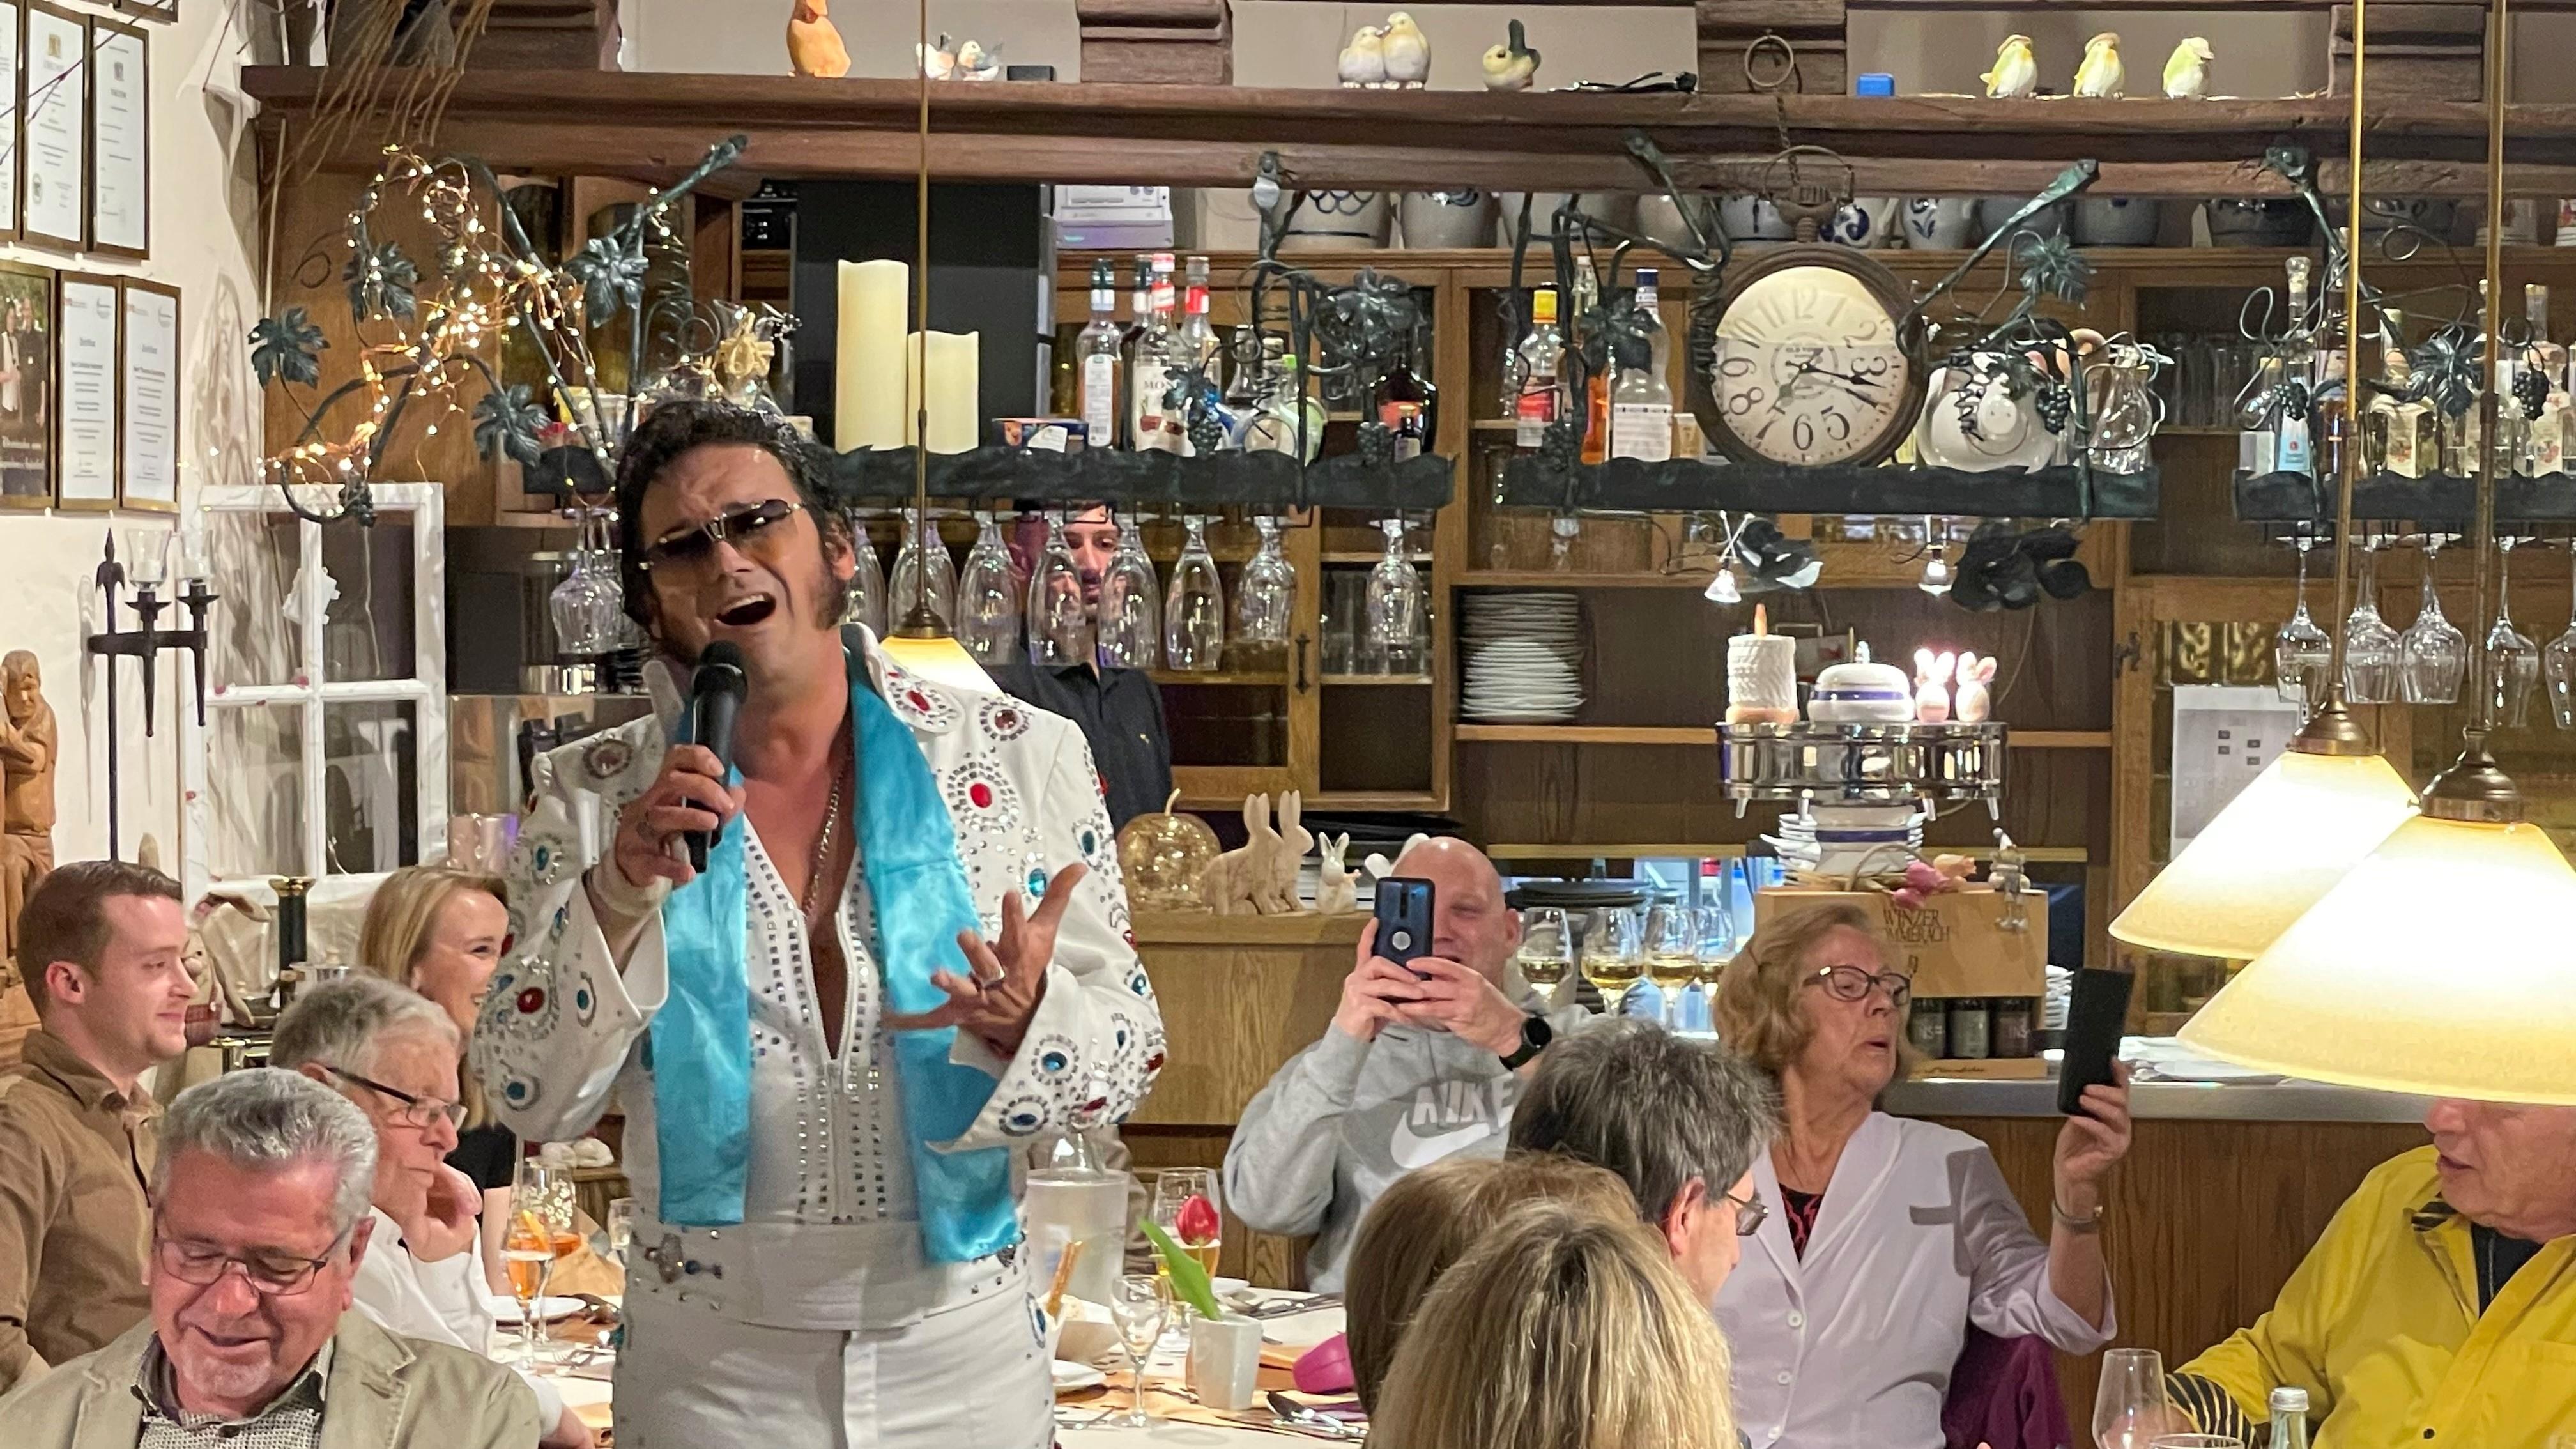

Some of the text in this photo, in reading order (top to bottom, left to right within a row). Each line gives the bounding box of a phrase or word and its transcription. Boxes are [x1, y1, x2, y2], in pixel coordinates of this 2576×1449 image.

[1729, 387, 1765, 415] 8
[1793, 414, 1814, 450] 6
[1821, 405, 1850, 441] 5
[1883, 909, 1942, 928] WINZER
[1411, 1071, 1515, 1128] NIKE
